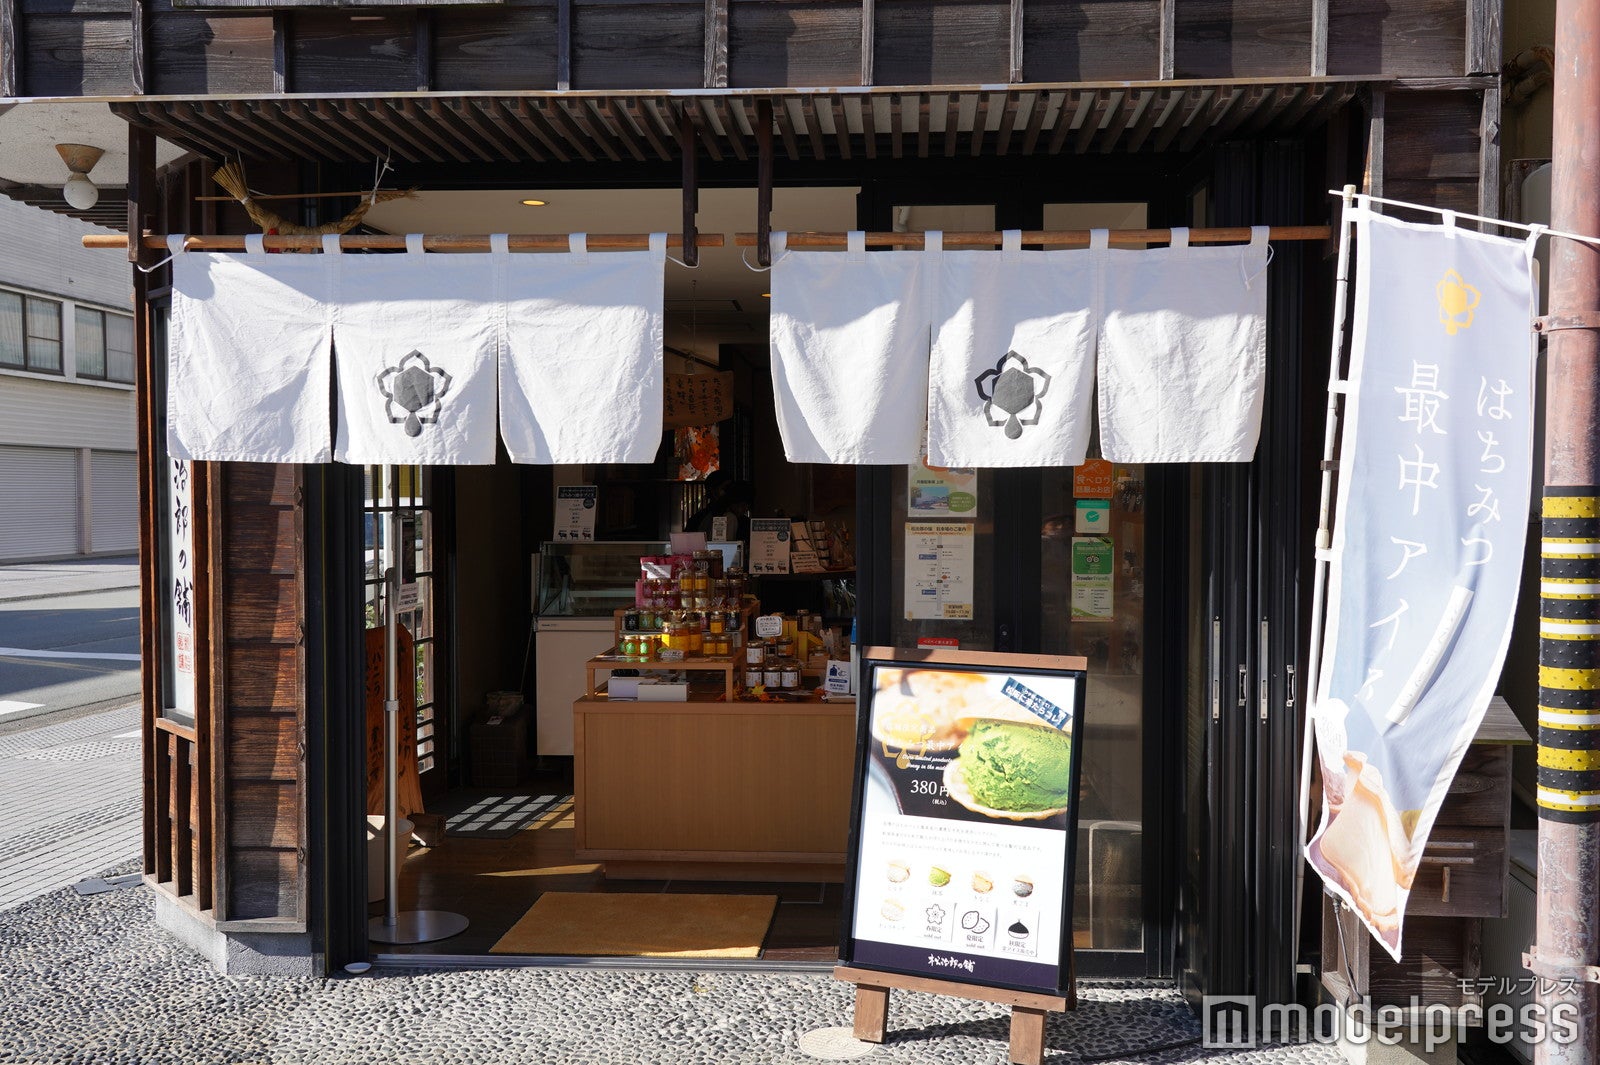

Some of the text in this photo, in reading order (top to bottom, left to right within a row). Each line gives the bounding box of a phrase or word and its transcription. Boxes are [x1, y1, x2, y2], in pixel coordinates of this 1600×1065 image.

[1461, 376, 1514, 566] はちみつ
[966, 934, 983, 943] 夏限定
